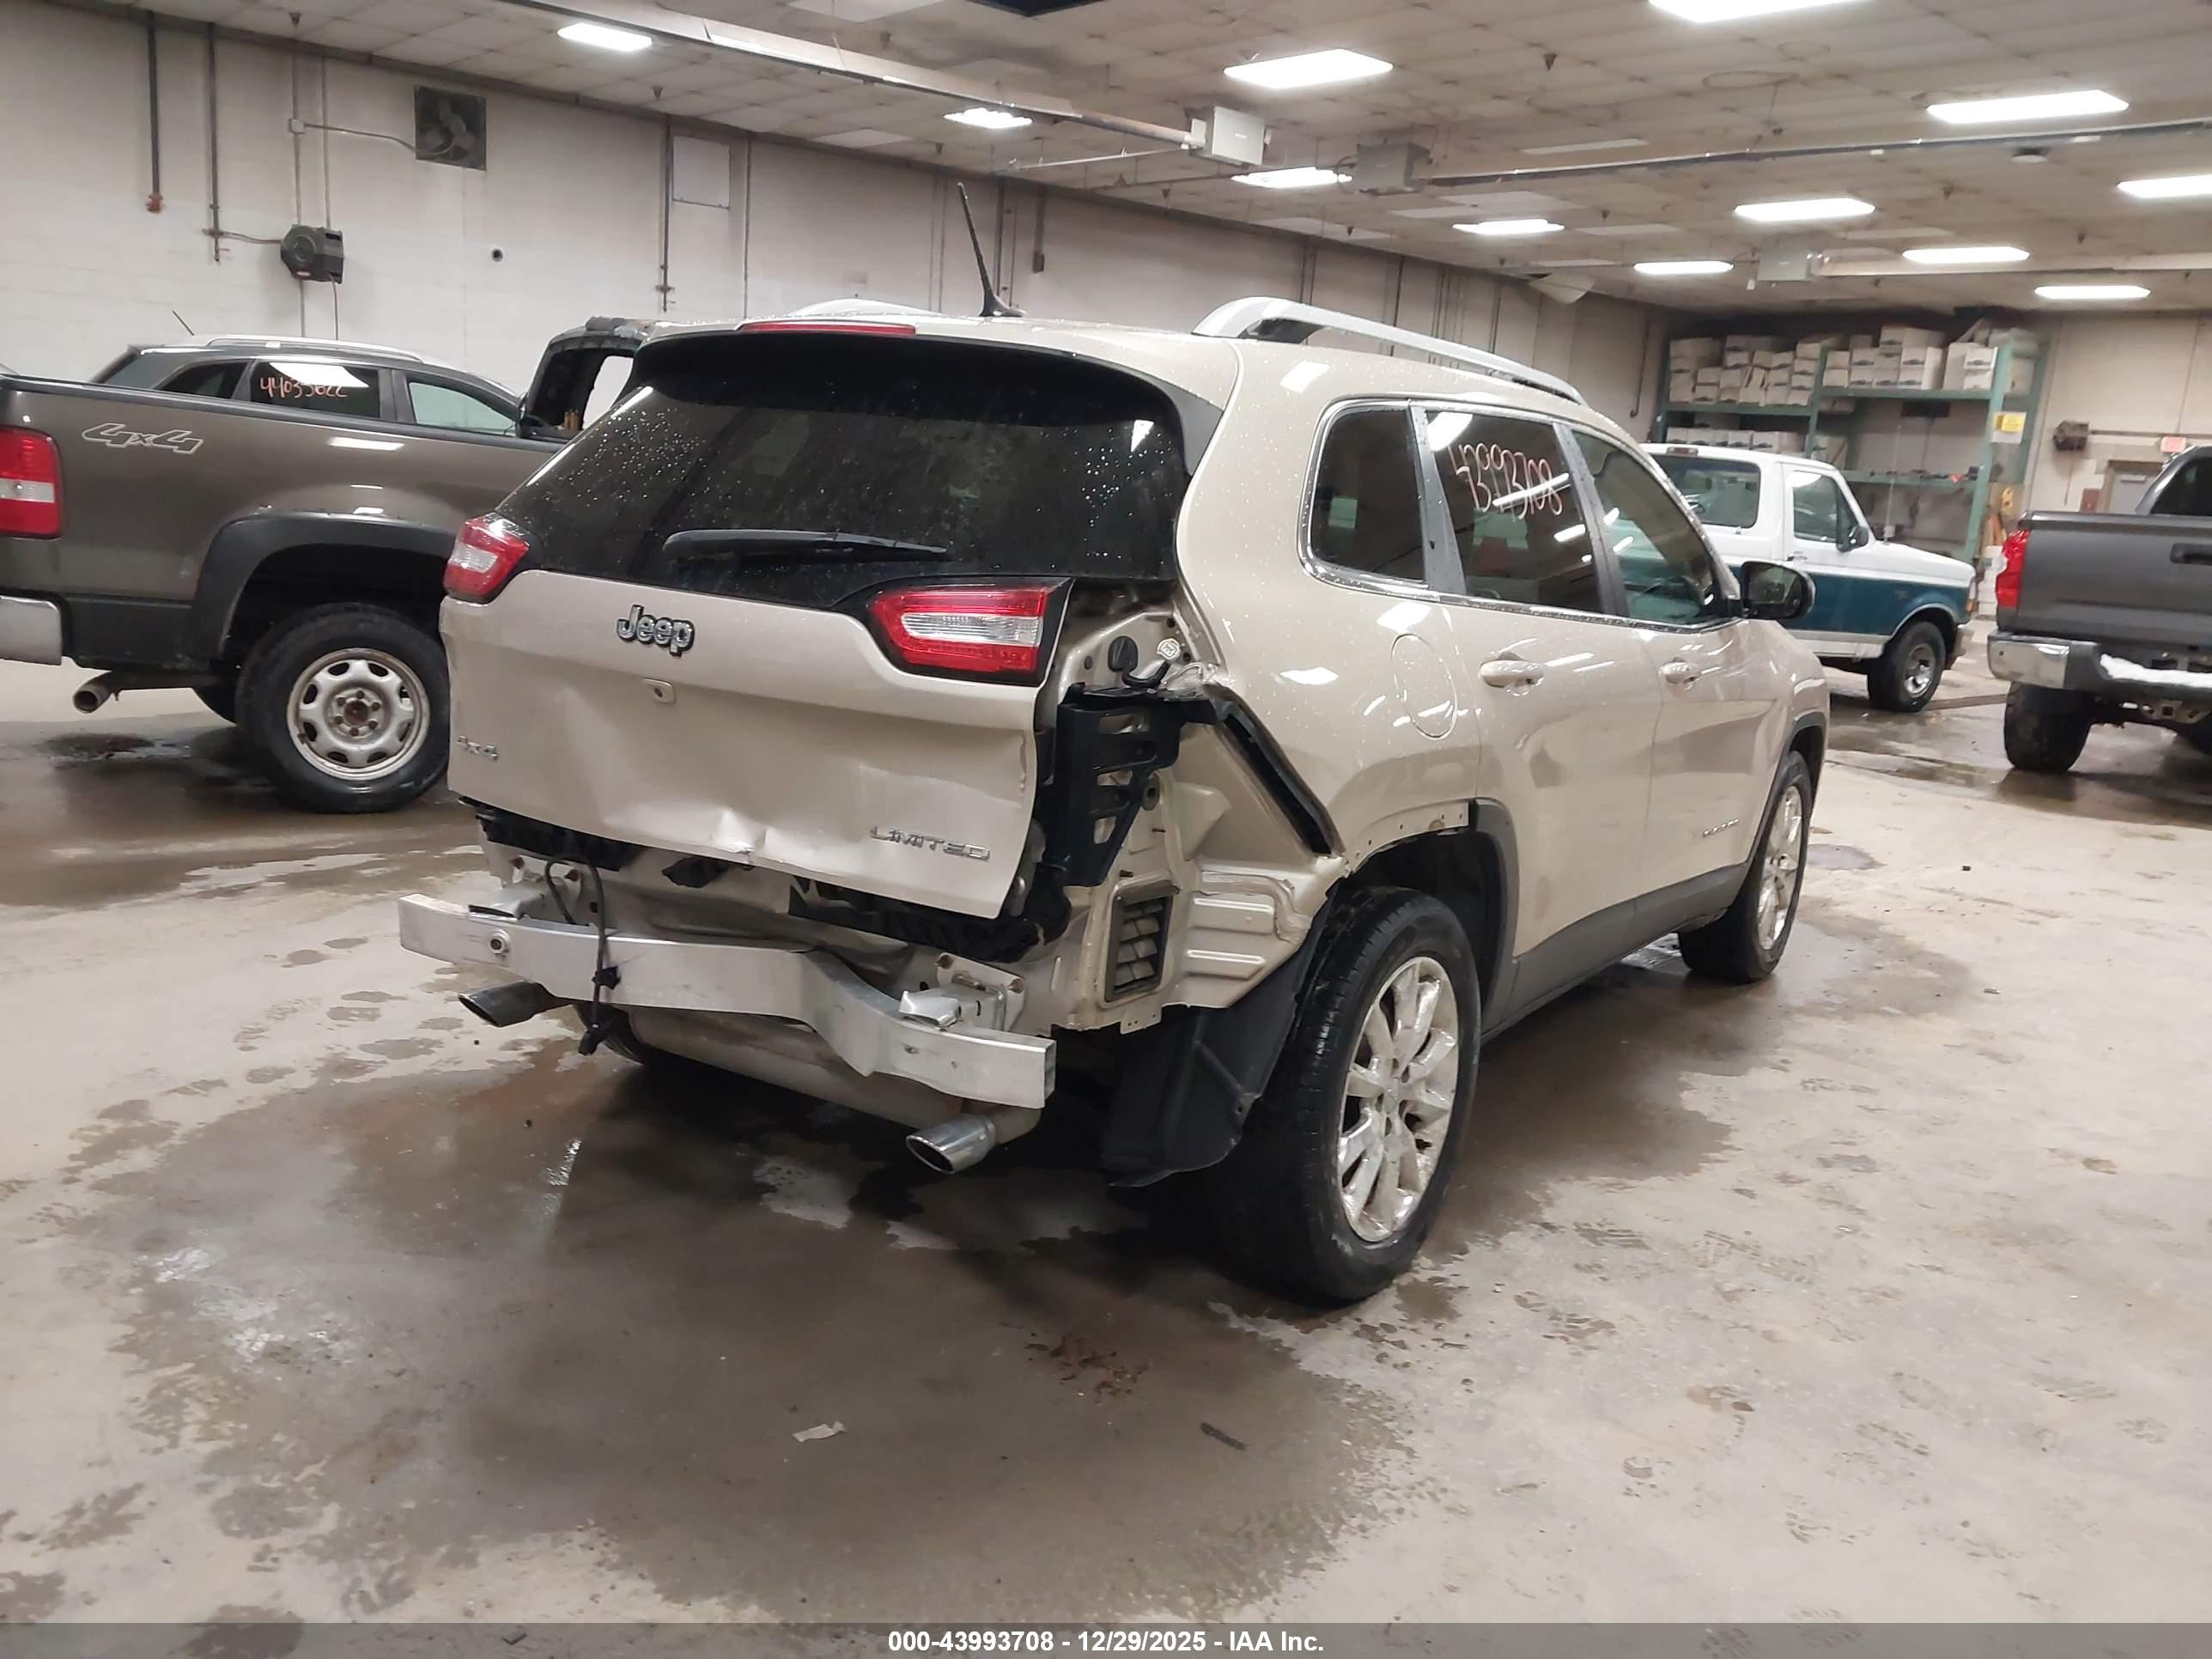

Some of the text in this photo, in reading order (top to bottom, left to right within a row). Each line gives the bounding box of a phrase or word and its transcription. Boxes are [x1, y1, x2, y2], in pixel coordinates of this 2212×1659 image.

[82, 422, 204, 454] 4x4
[617, 604, 696, 658] Jeep
[870, 825, 991, 861] LIMITED
